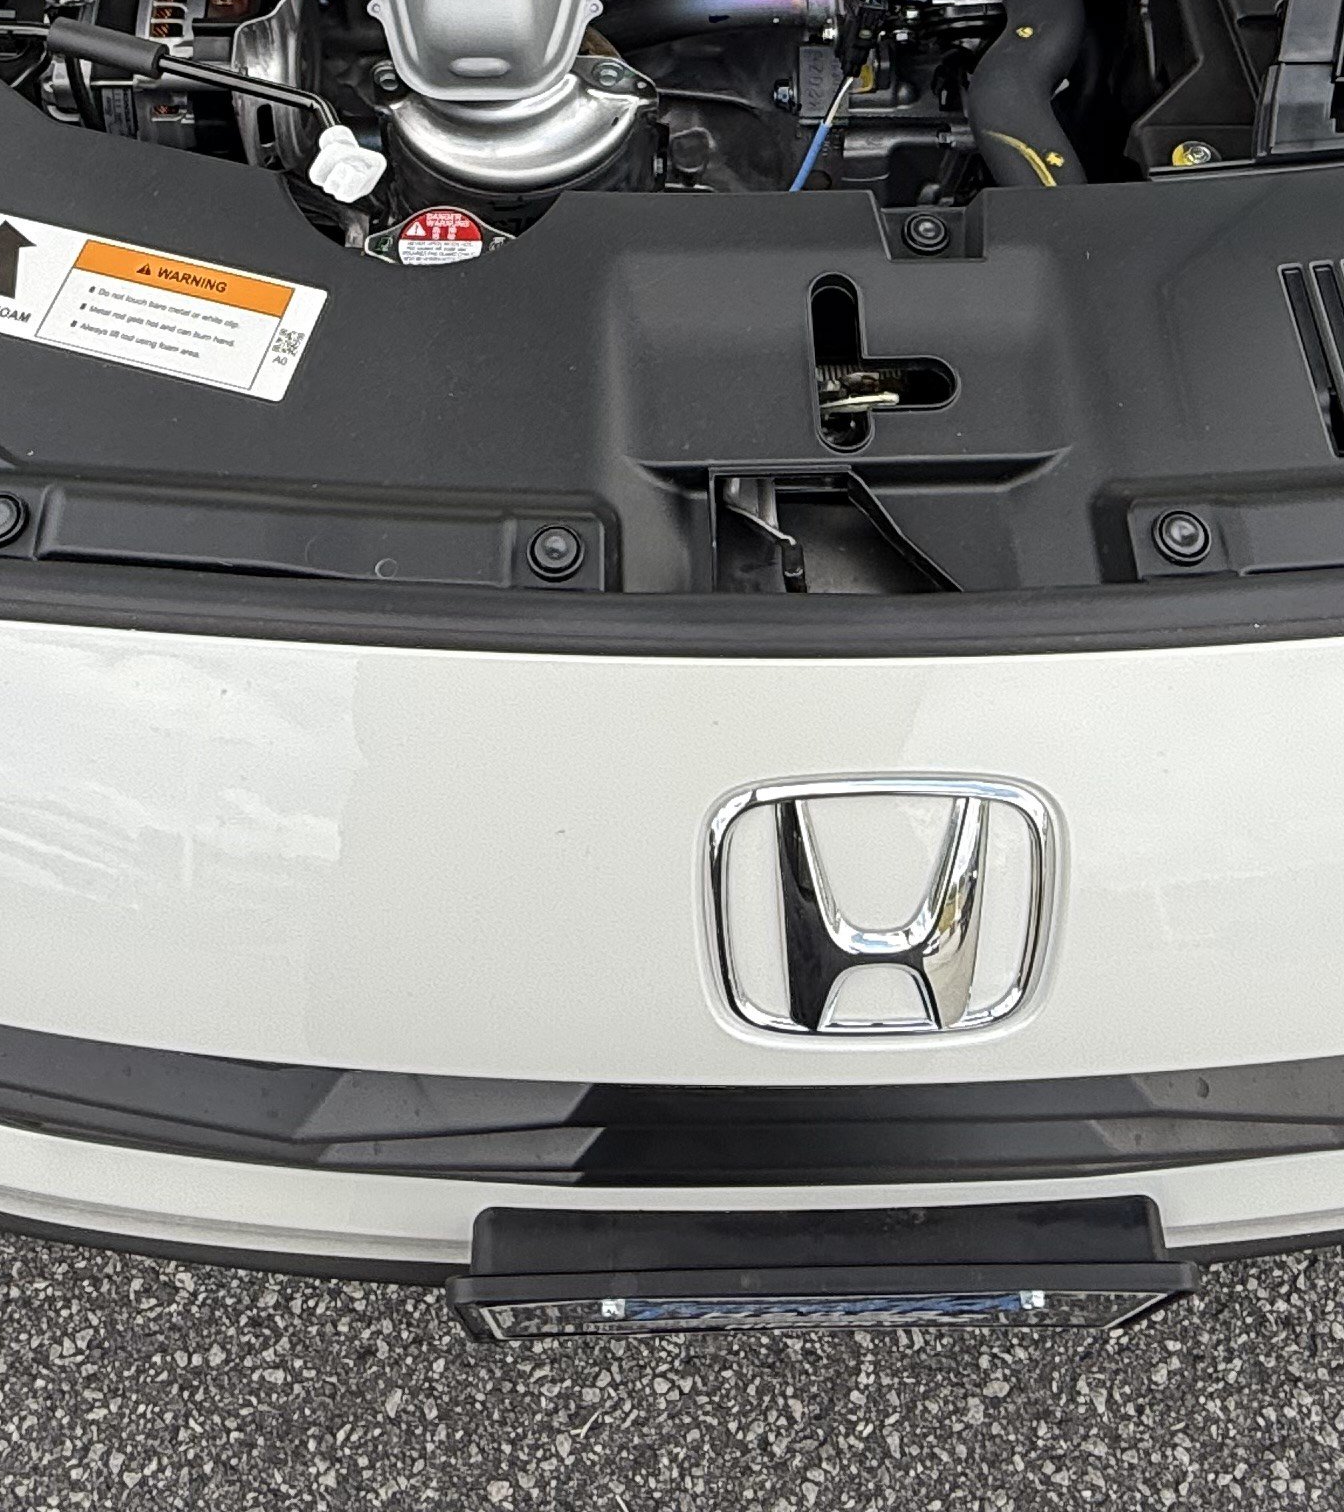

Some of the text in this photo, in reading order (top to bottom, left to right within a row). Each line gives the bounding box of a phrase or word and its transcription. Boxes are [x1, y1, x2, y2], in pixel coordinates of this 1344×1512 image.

[157, 266, 228, 294] WARNING
[98, 287, 110, 297] Do
[112, 291, 124, 300] not
[125, 294, 148, 306] touch
[80, 322, 108, 336] Always
[135, 337, 158, 349] using
[145, 319, 159, 329] hot
[160, 323, 176, 332] and
[177, 327, 192, 336] can
